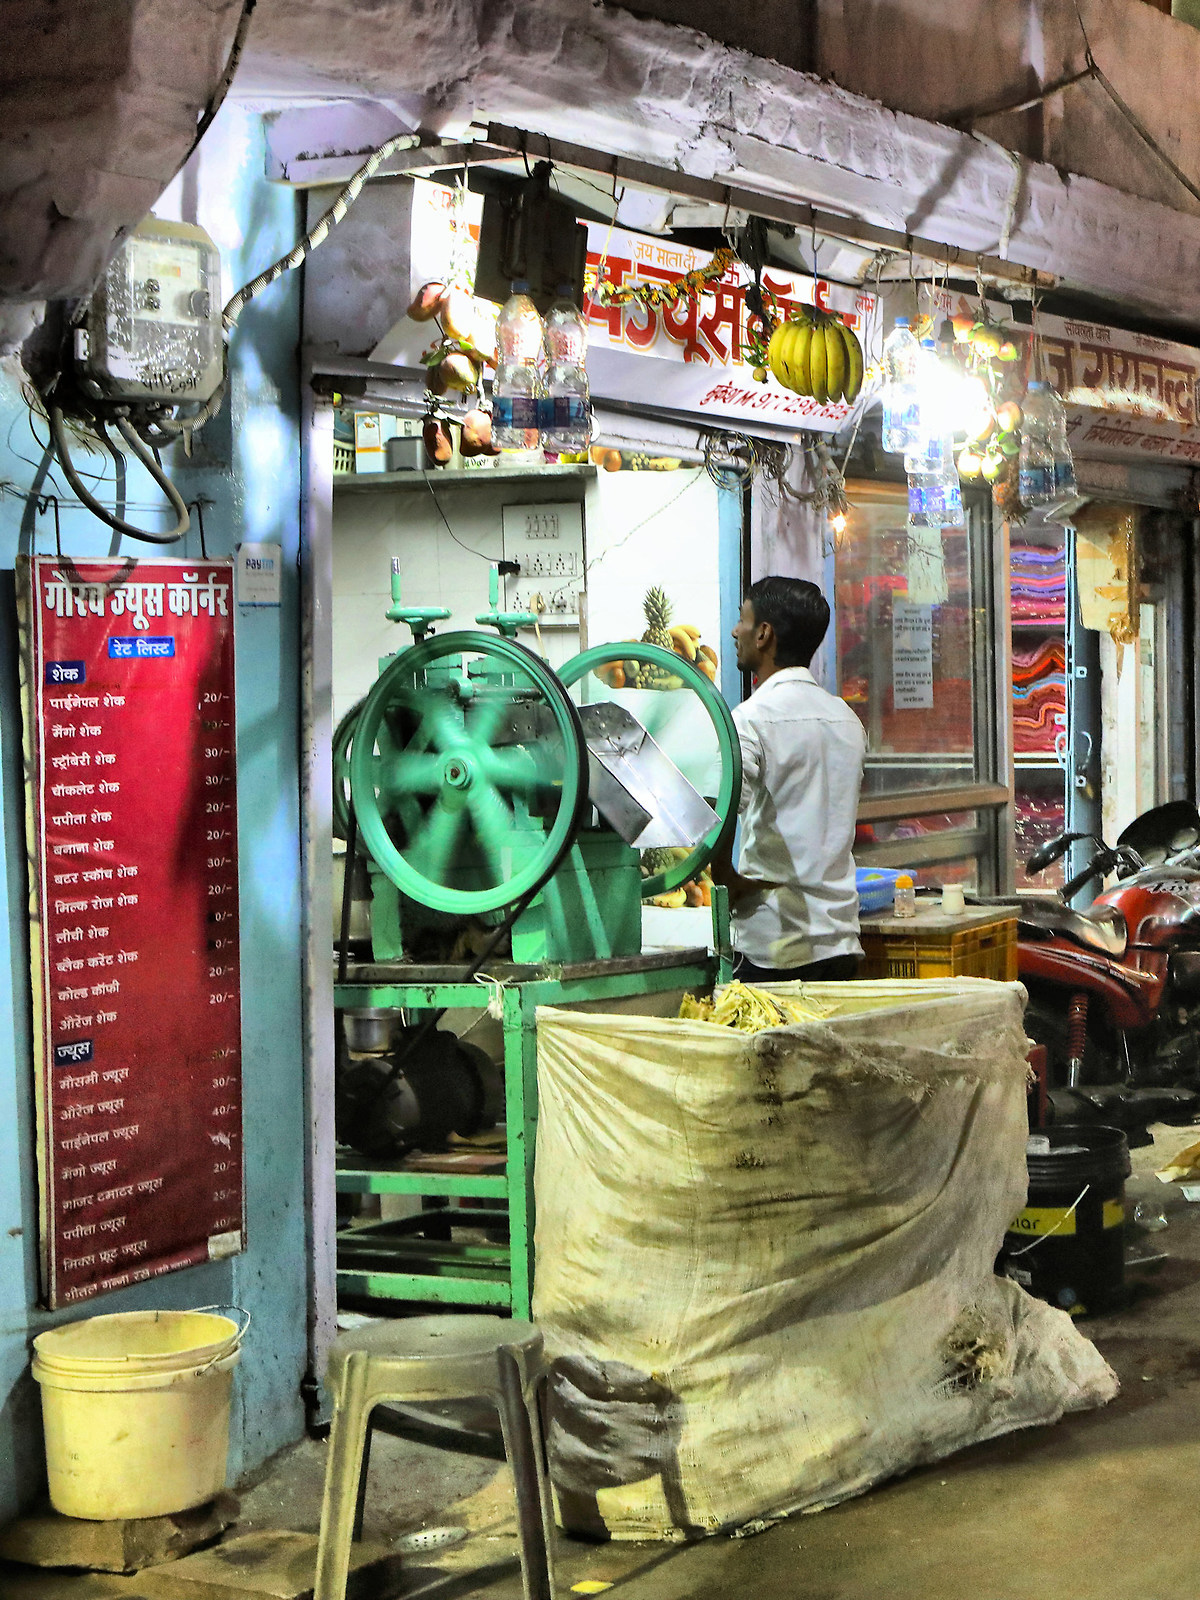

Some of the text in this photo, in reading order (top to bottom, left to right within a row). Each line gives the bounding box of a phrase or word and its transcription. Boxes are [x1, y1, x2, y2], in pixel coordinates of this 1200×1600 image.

[109, 583, 165, 630] ज्यूस
[167, 572, 229, 617] कॉर्नर
[113, 639, 170, 656] रेट लिस्ट
[52, 664, 79, 682] शेक
[103, 692, 126, 708] शेक
[203, 692, 230, 703] 20/-
[52, 722, 102, 738] मैंगो शेक
[94, 750, 117, 765] शेक
[204, 748, 230, 759] 30/-
[51, 779, 120, 797] चॉकलेट शेक
[205, 775, 230, 786] 30/-
[206, 802, 231, 813] 20/-
[52, 809, 112, 827] पपीता शेक
[206, 830, 231, 841] 20/-
[53, 838, 115, 855] बनाना शेक
[207, 857, 232, 868] 30/-
[54, 873, 78, 885] बटर
[117, 864, 138, 879] शेक
[208, 885, 232, 896] 20/-
[55, 893, 138, 914] मिल्क रोज शेक
[211, 912, 233, 922] 0/-
[55, 925, 109, 943] लीची शेक
[211, 939, 233, 950] 0/-
[56, 956, 84, 973] ब्लैक
[117, 950, 138, 964] शेक
[208, 966, 234, 978] 20/-
[58, 979, 120, 1002] कोल्ड कॉफी
[209, 994, 234, 1005] 20/-
[96, 1011, 118, 1025] शेक
[57, 1040, 91, 1059] ज्यूस
[59, 1067, 130, 1091] मौसमी ज्यूस
[212, 1077, 237, 1089] 30/-
[97, 1098, 125, 1115] ज्यूस
[212, 1104, 237, 1116] 40/-
[113, 1124, 140, 1142] ज्यूस
[90, 1159, 118, 1176] ज्यूस
[213, 1161, 237, 1173] 20/-
[62, 1177, 163, 1213] गाजर टमाटर ज्यूस
[63, 1216, 127, 1241] पपीता ज्यूस
[121, 1239, 148, 1256] ज्यूस
[65, 1281, 98, 1301] शीतल
[133, 1267, 150, 1281] रस
